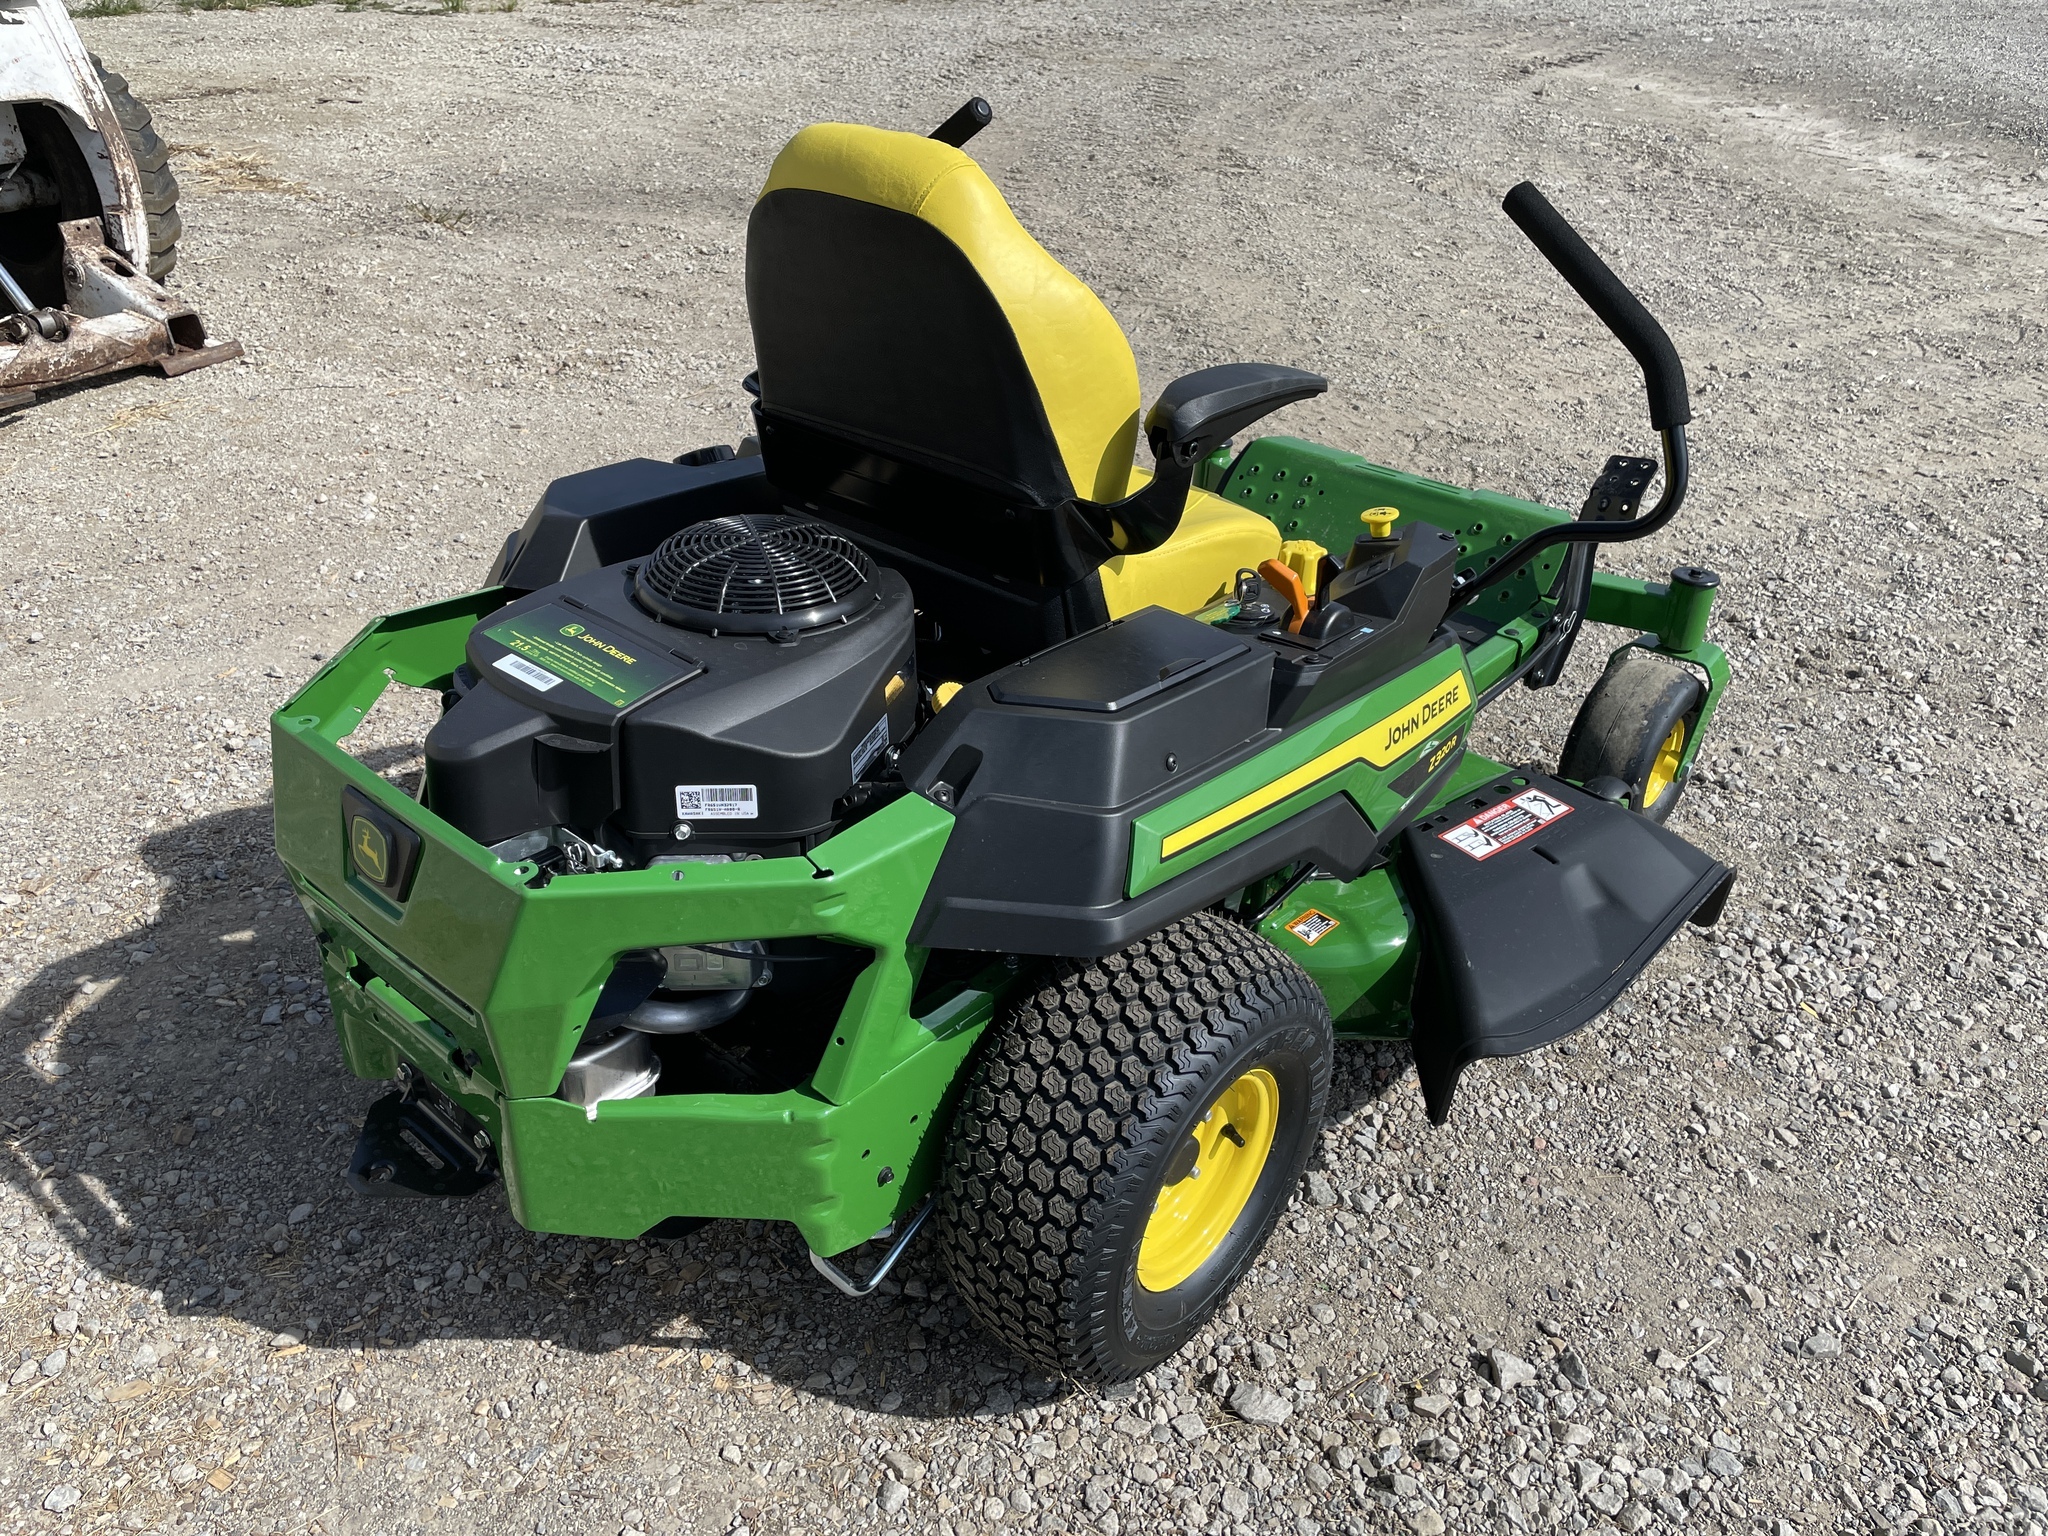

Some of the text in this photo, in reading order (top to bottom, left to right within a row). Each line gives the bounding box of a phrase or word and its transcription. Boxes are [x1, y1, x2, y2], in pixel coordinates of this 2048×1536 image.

[509, 638, 530, 653] 21.5
[577, 633, 606, 652] JOHN
[603, 644, 637, 666] DEERE
[1384, 685, 1459, 751] JOHN DEERE
[1427, 734, 1458, 773] Z320R
[1480, 803, 1511, 820] DANGER
